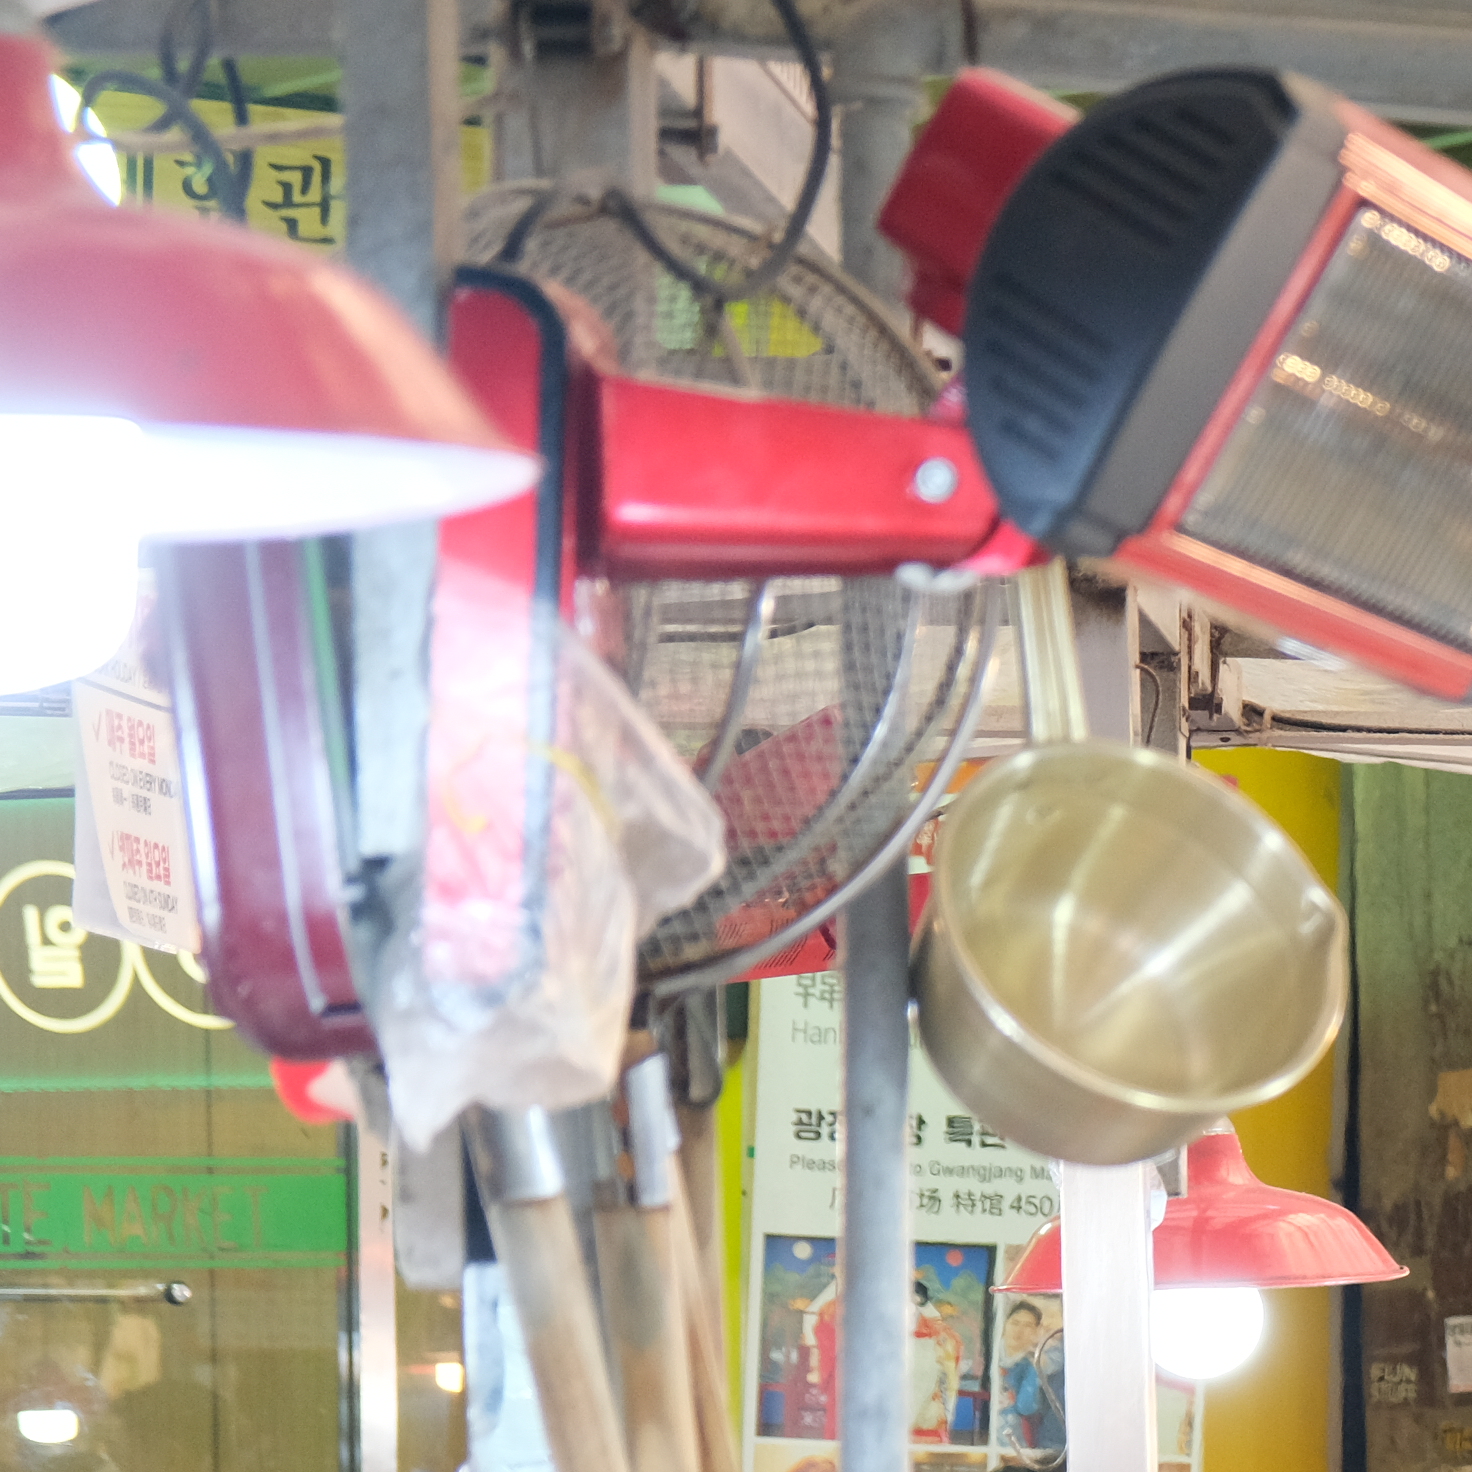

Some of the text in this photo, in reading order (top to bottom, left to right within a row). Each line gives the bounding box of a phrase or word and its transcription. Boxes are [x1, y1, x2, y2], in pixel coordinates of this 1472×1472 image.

[126, 715, 157, 766] 월요일
[143, 838, 172, 887] 일요일
[928, 1159, 1024, 1184] Gwangjang
[0, 1179, 270, 1251] TE MARKET
[1008, 1194, 1060, 1219] 450
